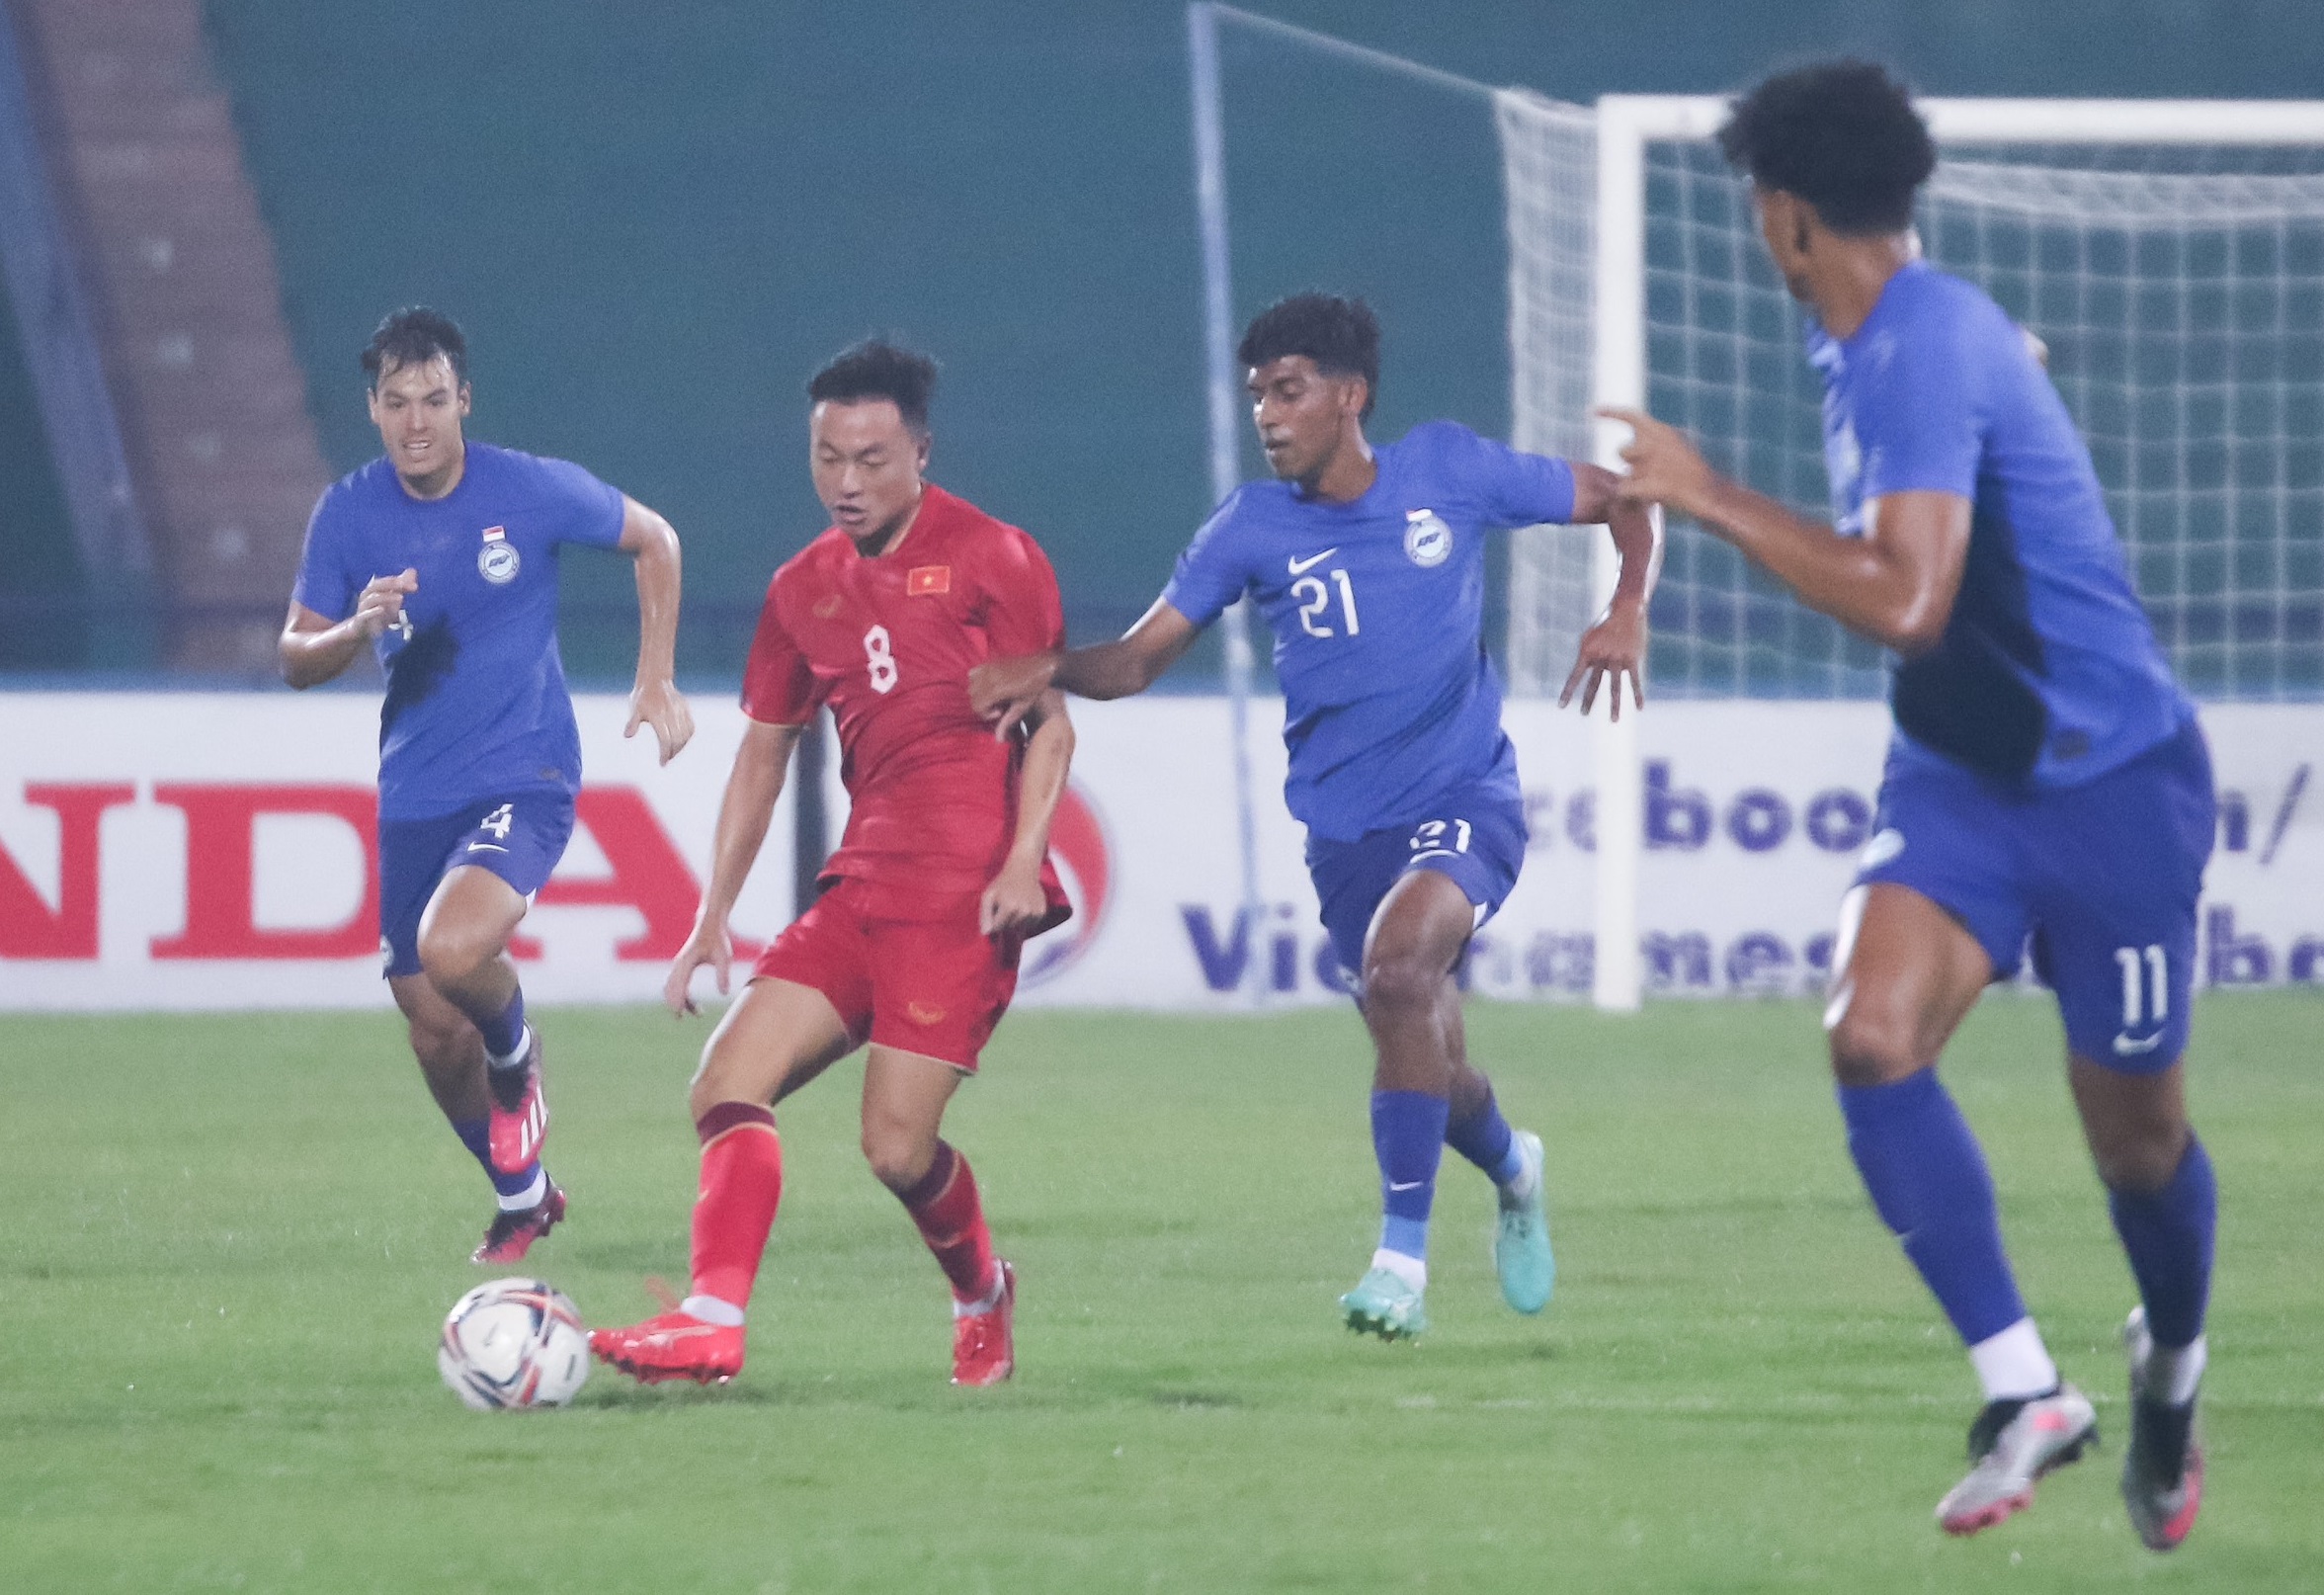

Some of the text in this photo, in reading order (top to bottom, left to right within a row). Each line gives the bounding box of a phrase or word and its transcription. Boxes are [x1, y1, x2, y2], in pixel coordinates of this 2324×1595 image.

[1289, 568, 1360, 638] 21
[863, 624, 898, 694] 8
[479, 802, 514, 839] 4
[1409, 817, 1472, 854] 21
[2116, 944, 2169, 1027] 11
